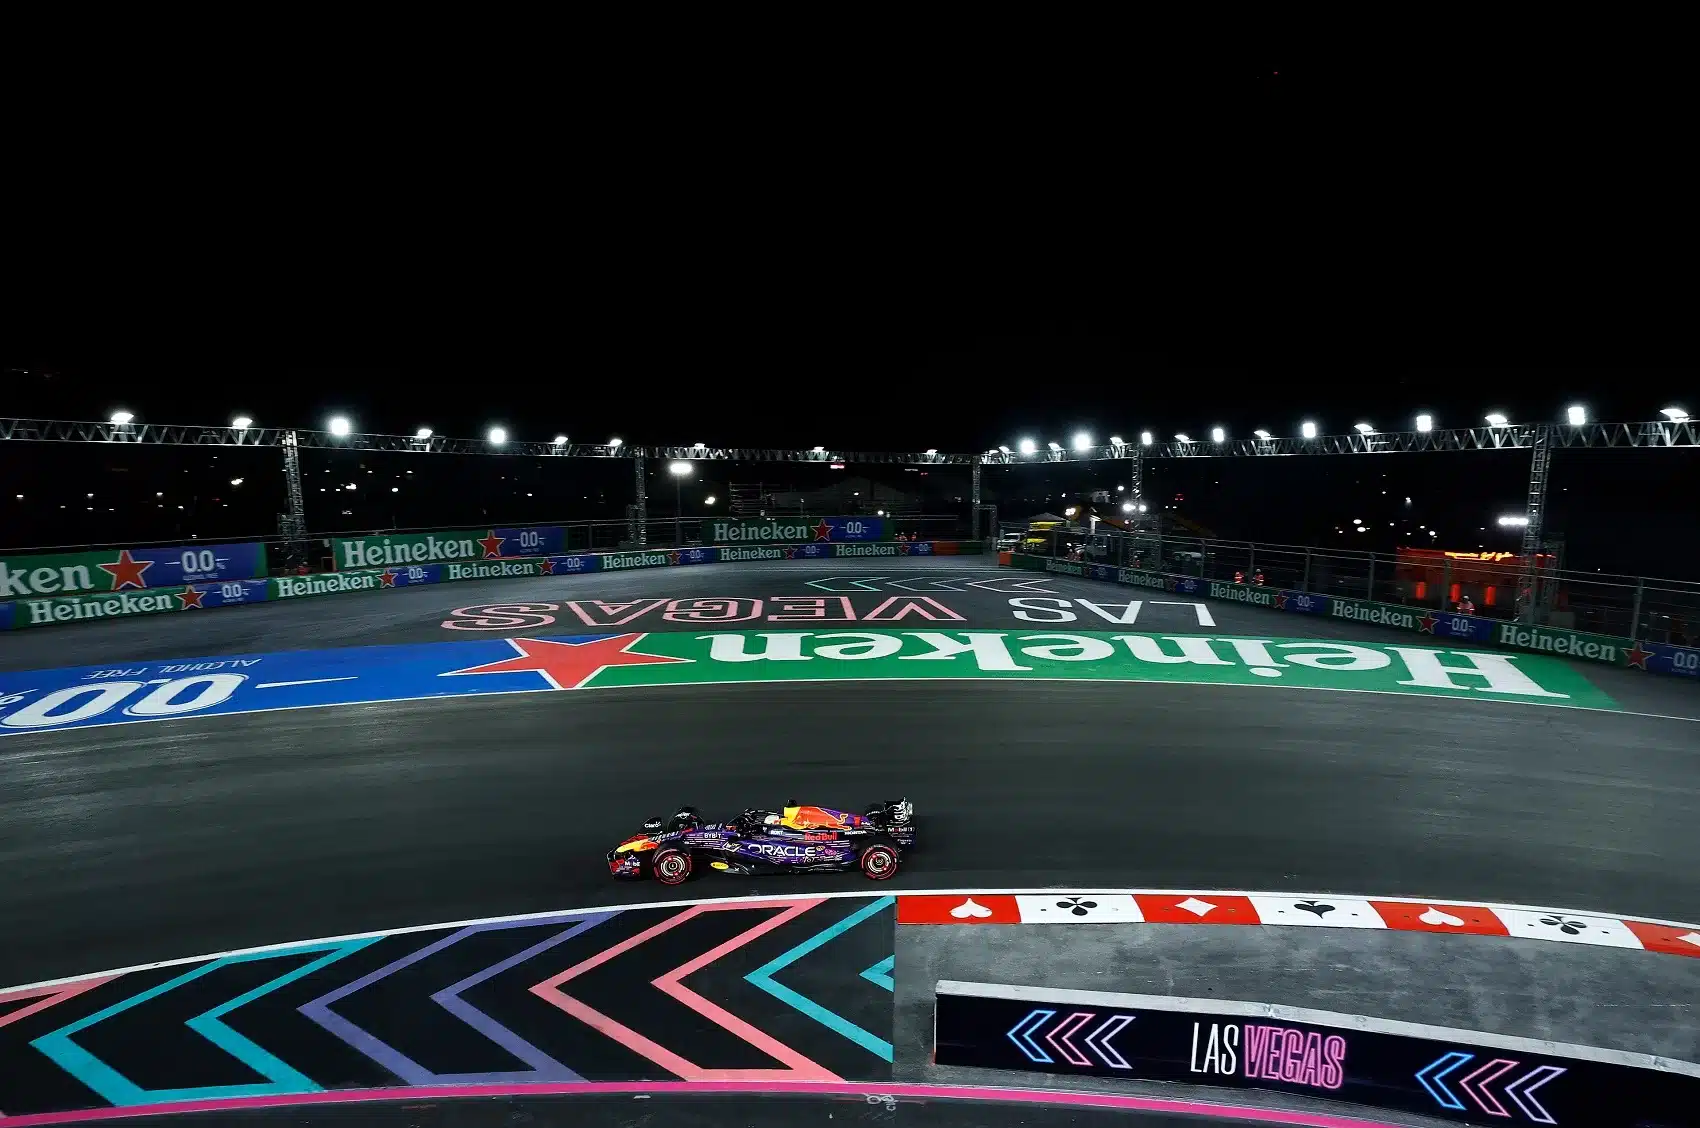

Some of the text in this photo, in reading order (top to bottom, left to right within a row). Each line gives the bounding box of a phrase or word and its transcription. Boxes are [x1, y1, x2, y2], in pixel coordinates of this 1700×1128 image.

[713, 522, 809, 541] Heineken
[342, 536, 475, 567] Heineken
[603, 553, 665, 569] Heineken
[720, 547, 781, 560] Heineken
[835, 544, 895, 556] Heineken
[448, 561, 534, 580] Heineken
[1046, 559, 1082, 575] Heineken
[277, 574, 375, 597] Heineken
[1118, 569, 1165, 588] Heineken
[1210, 582, 1270, 605] Heineken
[28, 594, 174, 624] Heineken
[440, 596, 1217, 631] LAS VEGAS
[1331, 600, 1414, 628] Heineken
[1500, 624, 1617, 662] Heineken
[81, 658, 262, 680] ALCOHOL FREE
[695, 632, 1571, 699] Heineken
[748, 844, 816, 857] ORACLE
[1190, 1022, 1347, 1090] LAS VEGAS
